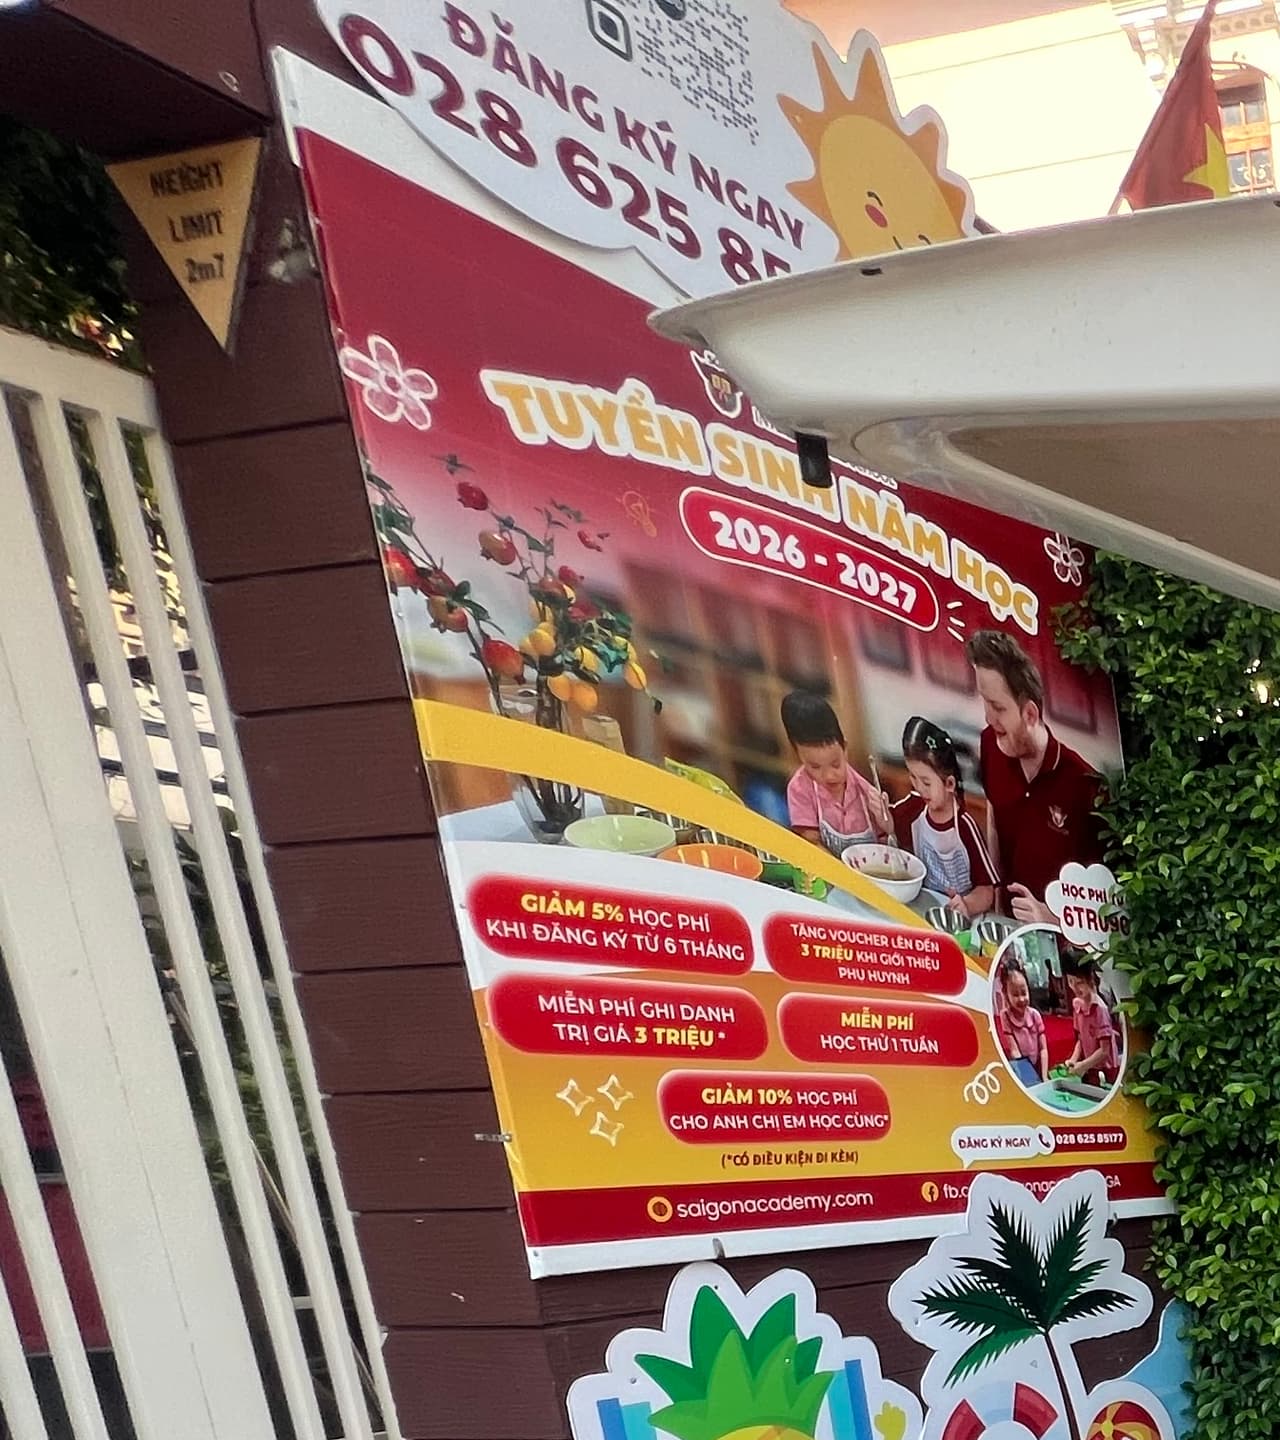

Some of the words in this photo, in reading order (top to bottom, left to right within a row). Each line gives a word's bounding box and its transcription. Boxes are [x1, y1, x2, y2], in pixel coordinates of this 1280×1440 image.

[338, 13, 538, 168] 028
[556, 136, 702, 260] 625
[441, 1, 605, 133] ĐĂNG
[614, 106, 677, 176] KÝ
[689, 152, 804, 250] NGAY
[150, 160, 223, 197] HEIGHT
[168, 209, 223, 242] LIMIT
[490, 378, 706, 468] TUYỂN
[844, 482, 946, 570] NĂM
[955, 547, 1034, 629] HỌC
[708, 510, 807, 570] 2026
[836, 553, 917, 613] 2027
[521, 890, 585, 918] GIẢM
[592, 902, 624, 922] 5%
[628, 907, 673, 930] HỌC
[678, 911, 711, 933] PHÍ
[486, 919, 527, 940] KHI
[532, 922, 597, 947] ĐĂNG
[602, 928, 627, 949] KÝ
[632, 932, 660, 953] TỪ
[664, 938, 676, 954] 6
[678, 937, 745, 961] THÁNG
[790, 922, 827, 941] TẶNG
[828, 929, 889, 948] VOUCHER
[891, 935, 913, 950] LÊN
[801, 944, 810, 956] 3
[812, 944, 853, 963] TRIỆU
[856, 950, 878, 963] KHI
[905, 956, 940, 972] THIỆU
[838, 966, 865, 983] PHỤ
[868, 969, 910, 985] HUYNH
[537, 989, 595, 1015] MIỄN
[600, 997, 635, 1017] PHÍ
[640, 1001, 675, 1019] GHI
[680, 1005, 735, 1023] DANH
[841, 1006, 883, 1030] MIỄN
[887, 1012, 914, 1031] PHÍ
[553, 1023, 589, 1046] TRỊ
[593, 1022, 631, 1043] GIÁ
[634, 1026, 647, 1044] 3
[652, 1025, 714, 1050] TRIỆU
[820, 1034, 856, 1054] HỌC
[891, 1038, 898, 1052] 1
[701, 1082, 753, 1105] GIẢM
[757, 1088, 793, 1106] 10%
[796, 1091, 830, 1109] HỌC
[833, 1088, 858, 1106] PHÍ
[670, 1115, 708, 1130] CHO
[713, 1115, 749, 1130] ANH
[752, 1115, 780, 1133] CHỊ
[784, 1115, 806, 1129] EM
[810, 1114, 842, 1132] HỌC
[958, 1135, 989, 1149] ĐĂNG
[1004, 1137, 1032, 1148] NGAY
[1056, 1133, 1076, 1145] 028
[1077, 1133, 1096, 1144] 625
[785, 1149, 814, 1167] KIỆN
[676, 1190, 874, 1222] saigonacademy.com
